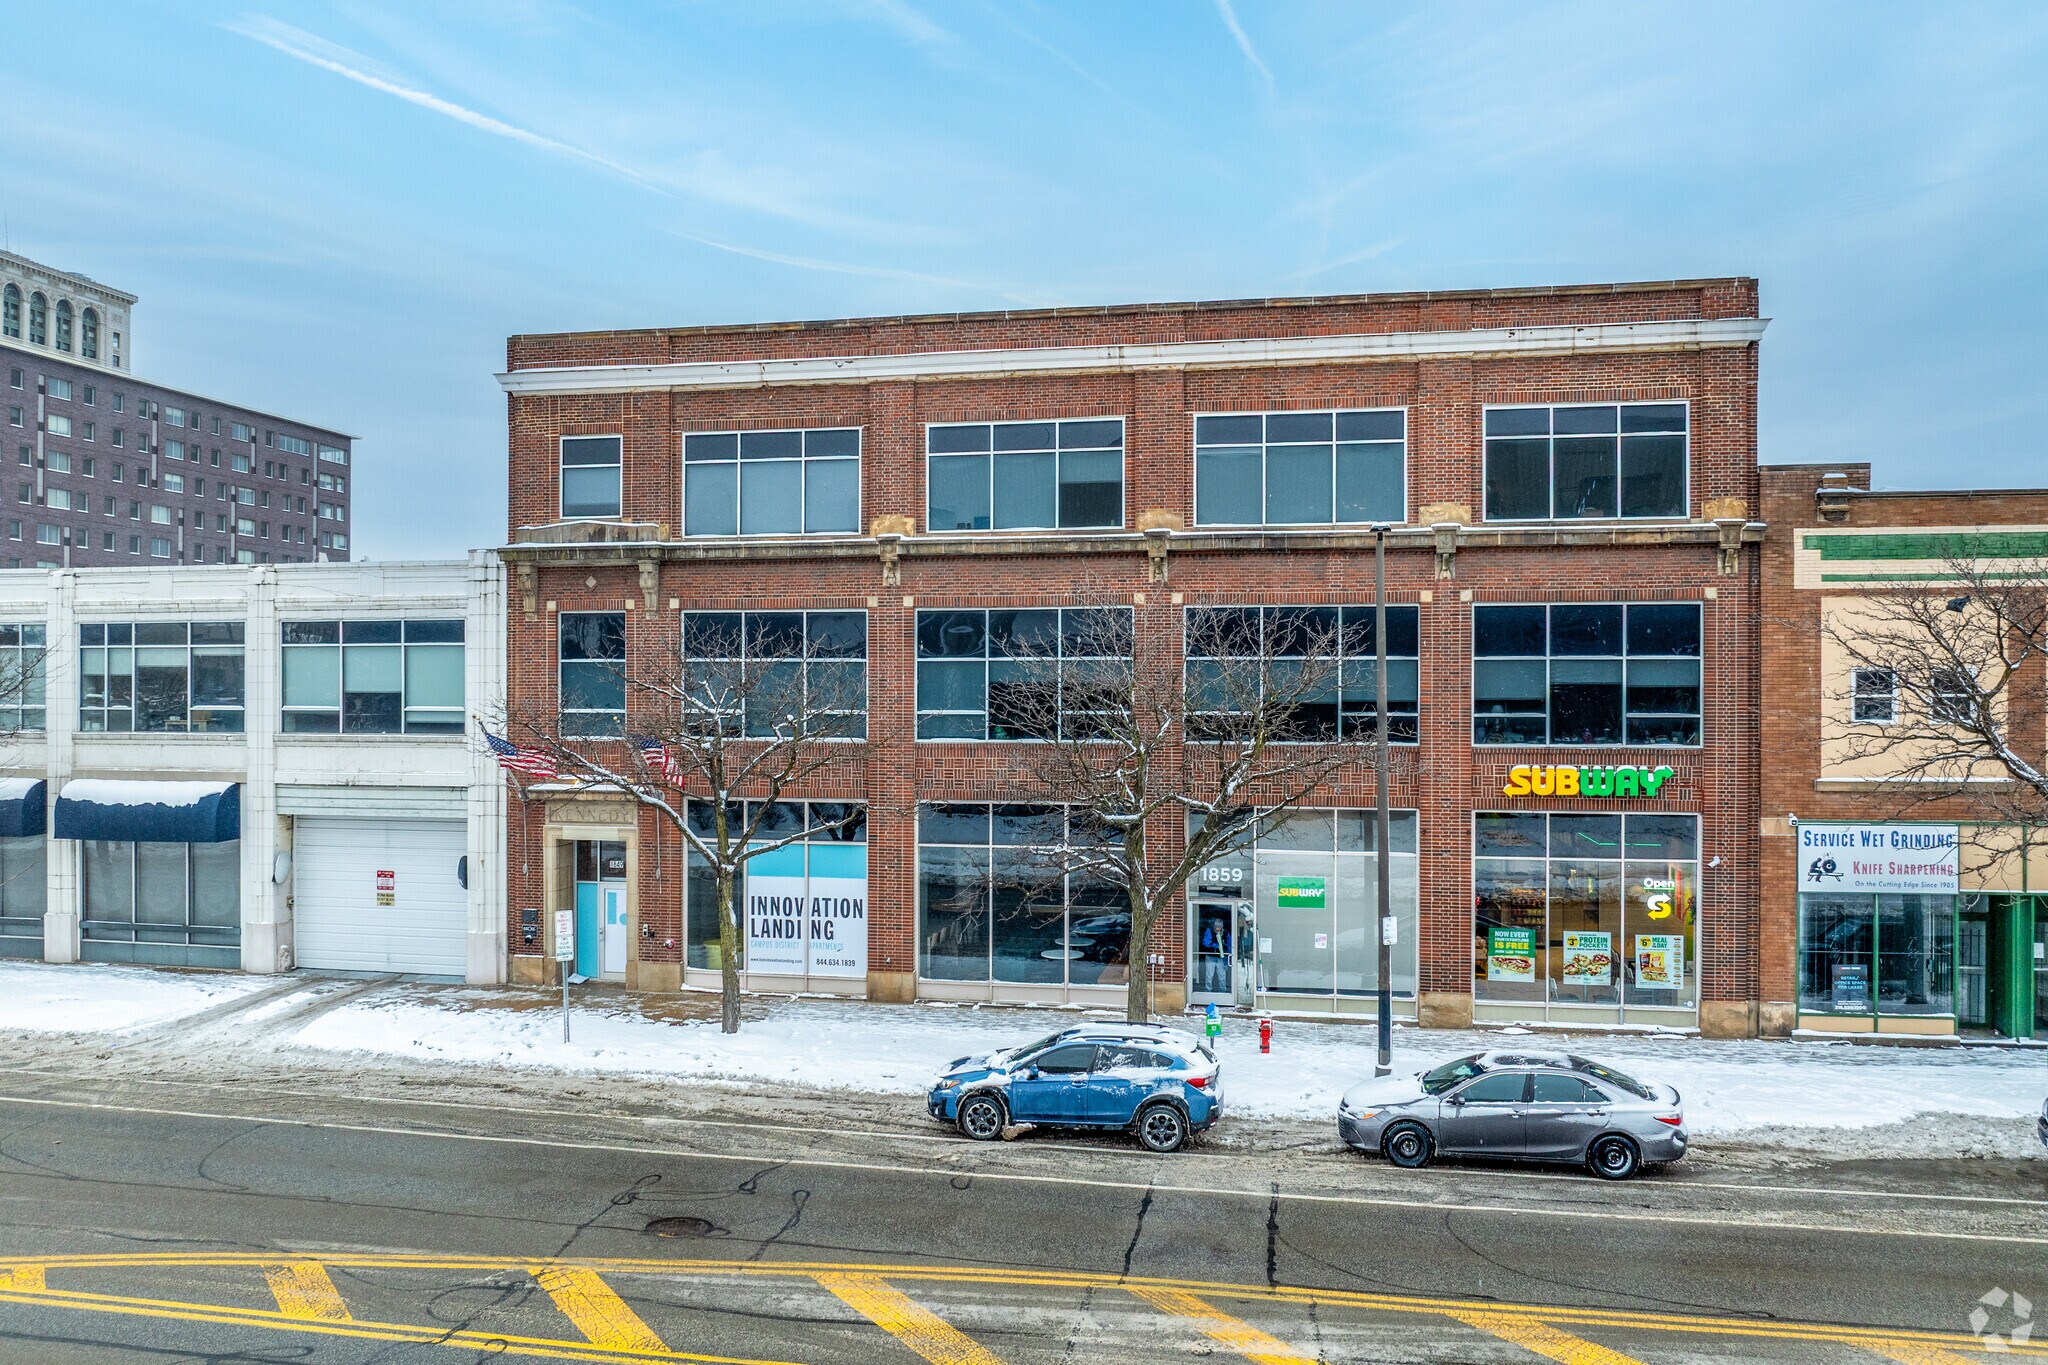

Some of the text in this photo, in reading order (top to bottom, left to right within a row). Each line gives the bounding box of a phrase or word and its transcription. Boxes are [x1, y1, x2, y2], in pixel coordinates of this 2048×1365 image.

[1503, 765, 1674, 798] SUBWAY
[555, 808, 629, 822] KENNEDY
[1804, 830, 1953, 848] SERVICE WET GRINDING
[1200, 867, 1243, 882] 1859
[1853, 861, 1954, 876] KNIFE SHARPENING
[1643, 878, 1675, 888] Open
[1879, 881, 1902, 889] Cutting
[1278, 887, 1325, 897] SUBWAY
[751, 896, 863, 918] INNOVATION
[751, 918, 834, 940] LANDING
[751, 940, 844, 951] CAMPUS DISTRICT APARTMENTS
[816, 958, 856, 966] 844.634.1839
